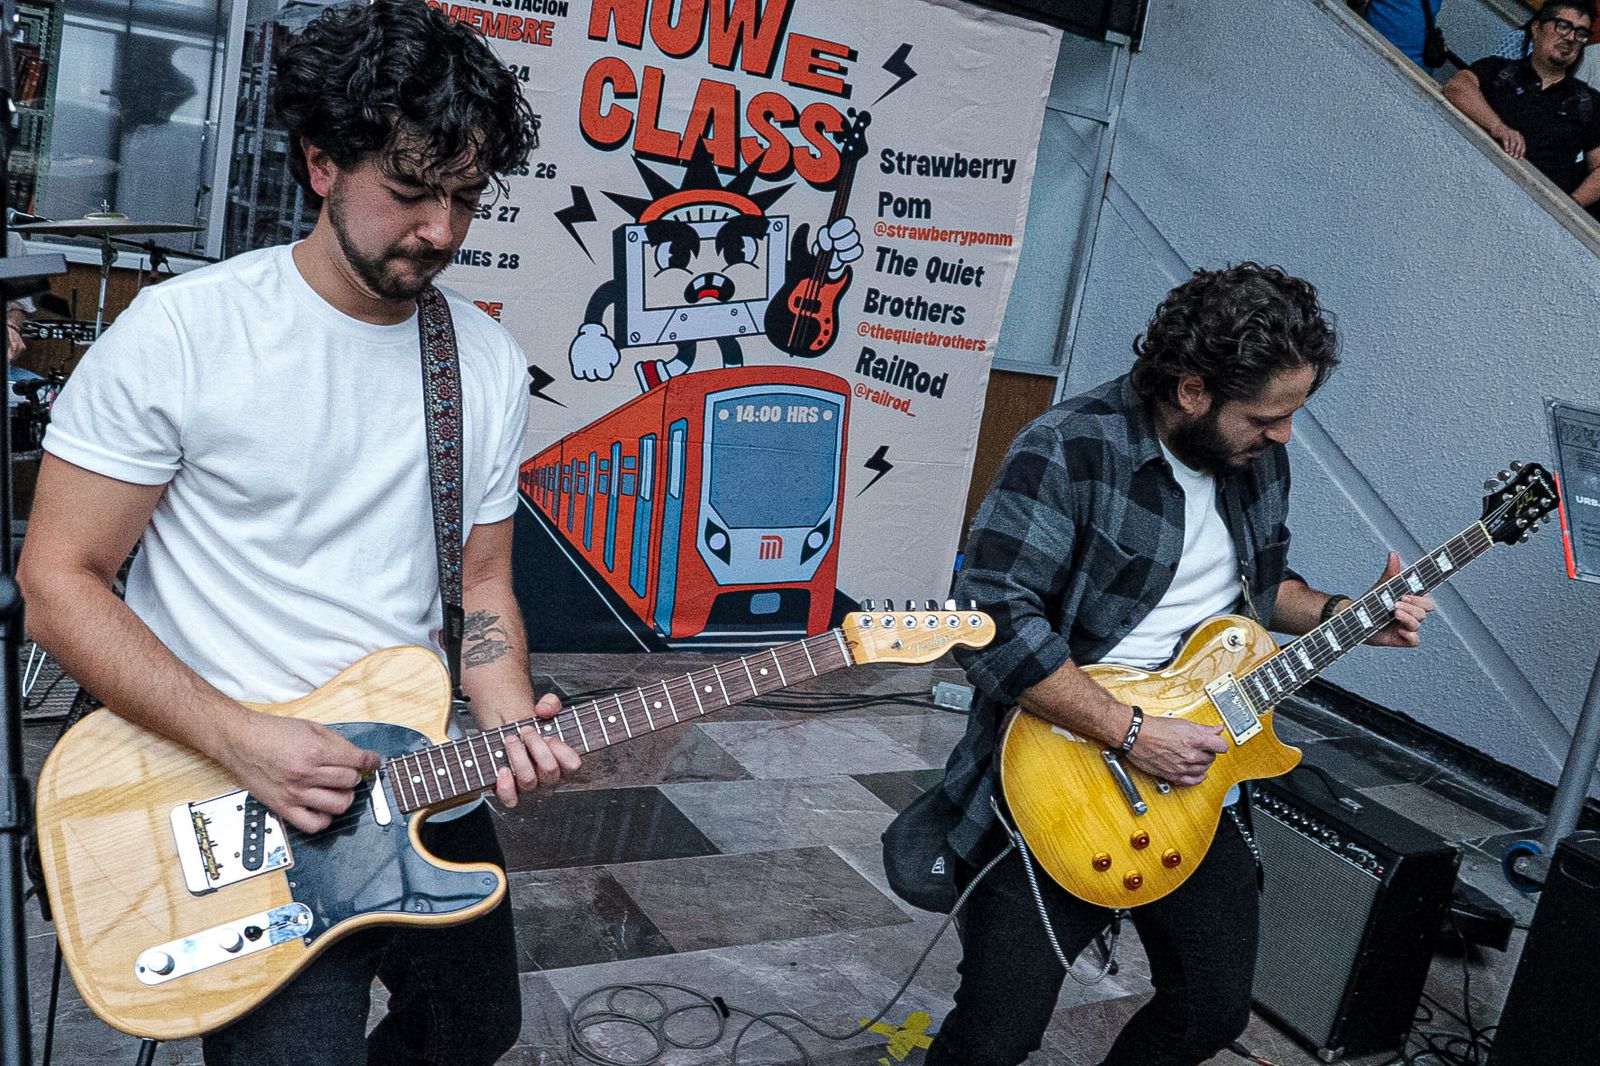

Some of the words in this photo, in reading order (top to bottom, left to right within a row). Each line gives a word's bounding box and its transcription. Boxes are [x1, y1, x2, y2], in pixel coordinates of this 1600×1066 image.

[579, 56, 845, 191] CLASS
[535, 162, 557, 180] 26
[879, 148, 1017, 184] Strawberry
[497, 206, 520, 223] 27
[877, 191, 931, 219] Pom
[873, 221, 1013, 247] @strawberrypomm
[497, 253, 520, 269] 28
[875, 246, 919, 277] The
[925, 256, 985, 288] Quiet
[863, 287, 966, 325] Brothers
[856, 321, 987, 352] @thequietbrothers
[855, 346, 949, 399] RailRod
[735, 404, 782, 422] 14:00
[786, 405, 819, 423] HRS
[853, 382, 916, 417] @railrod_
[1575, 495, 1600, 507] URB
